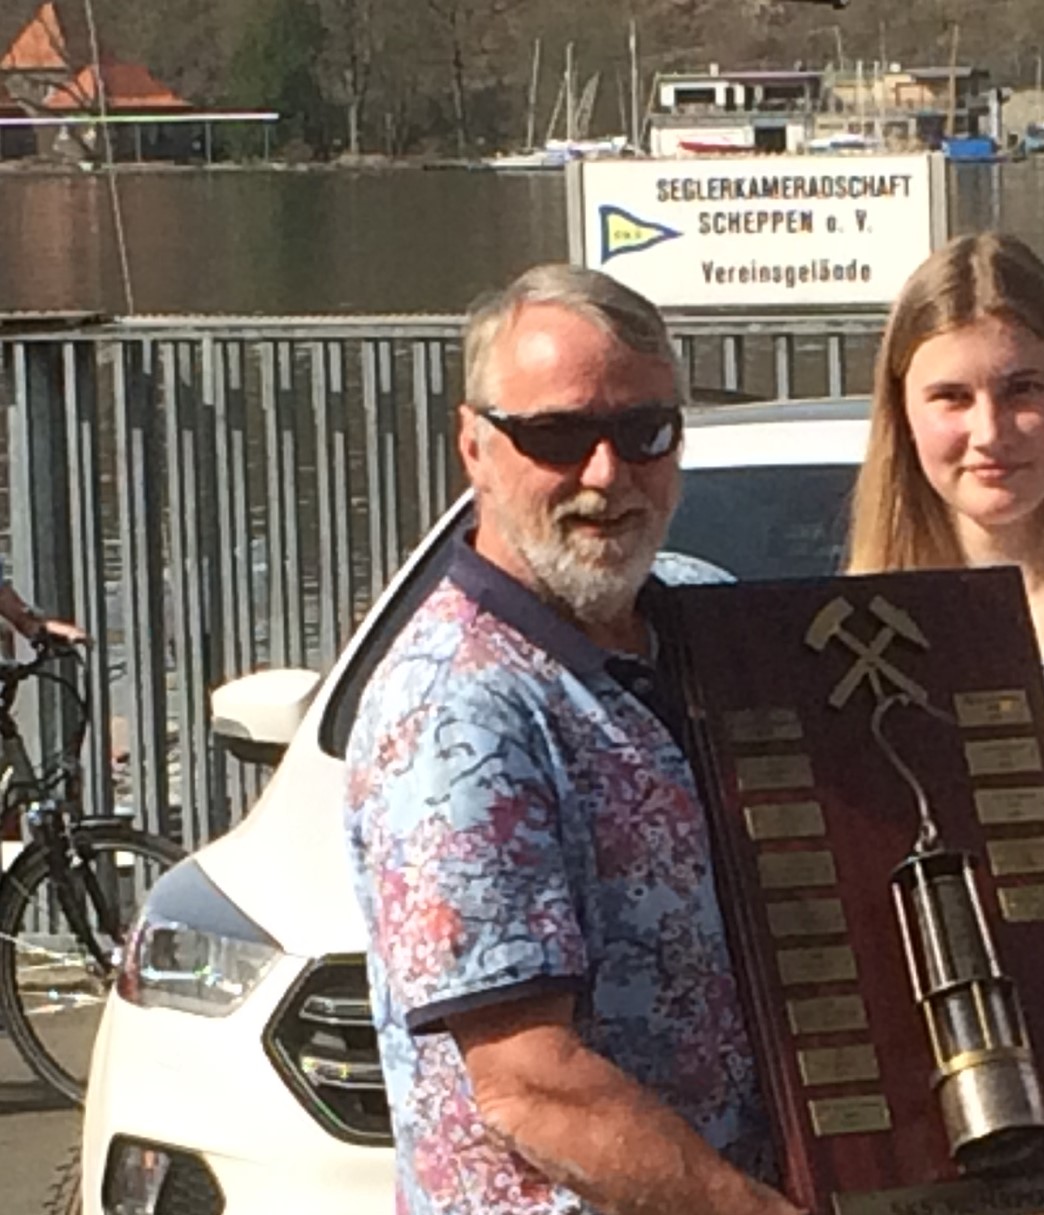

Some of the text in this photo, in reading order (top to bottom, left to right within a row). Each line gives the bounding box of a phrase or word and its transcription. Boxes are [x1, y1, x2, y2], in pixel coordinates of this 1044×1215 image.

[656, 175, 912, 202] SEGLERKAMERADSCHAFT
[698, 210, 813, 235] SCHEPPEN
[701, 259, 871, 288] Vereinsgelände
